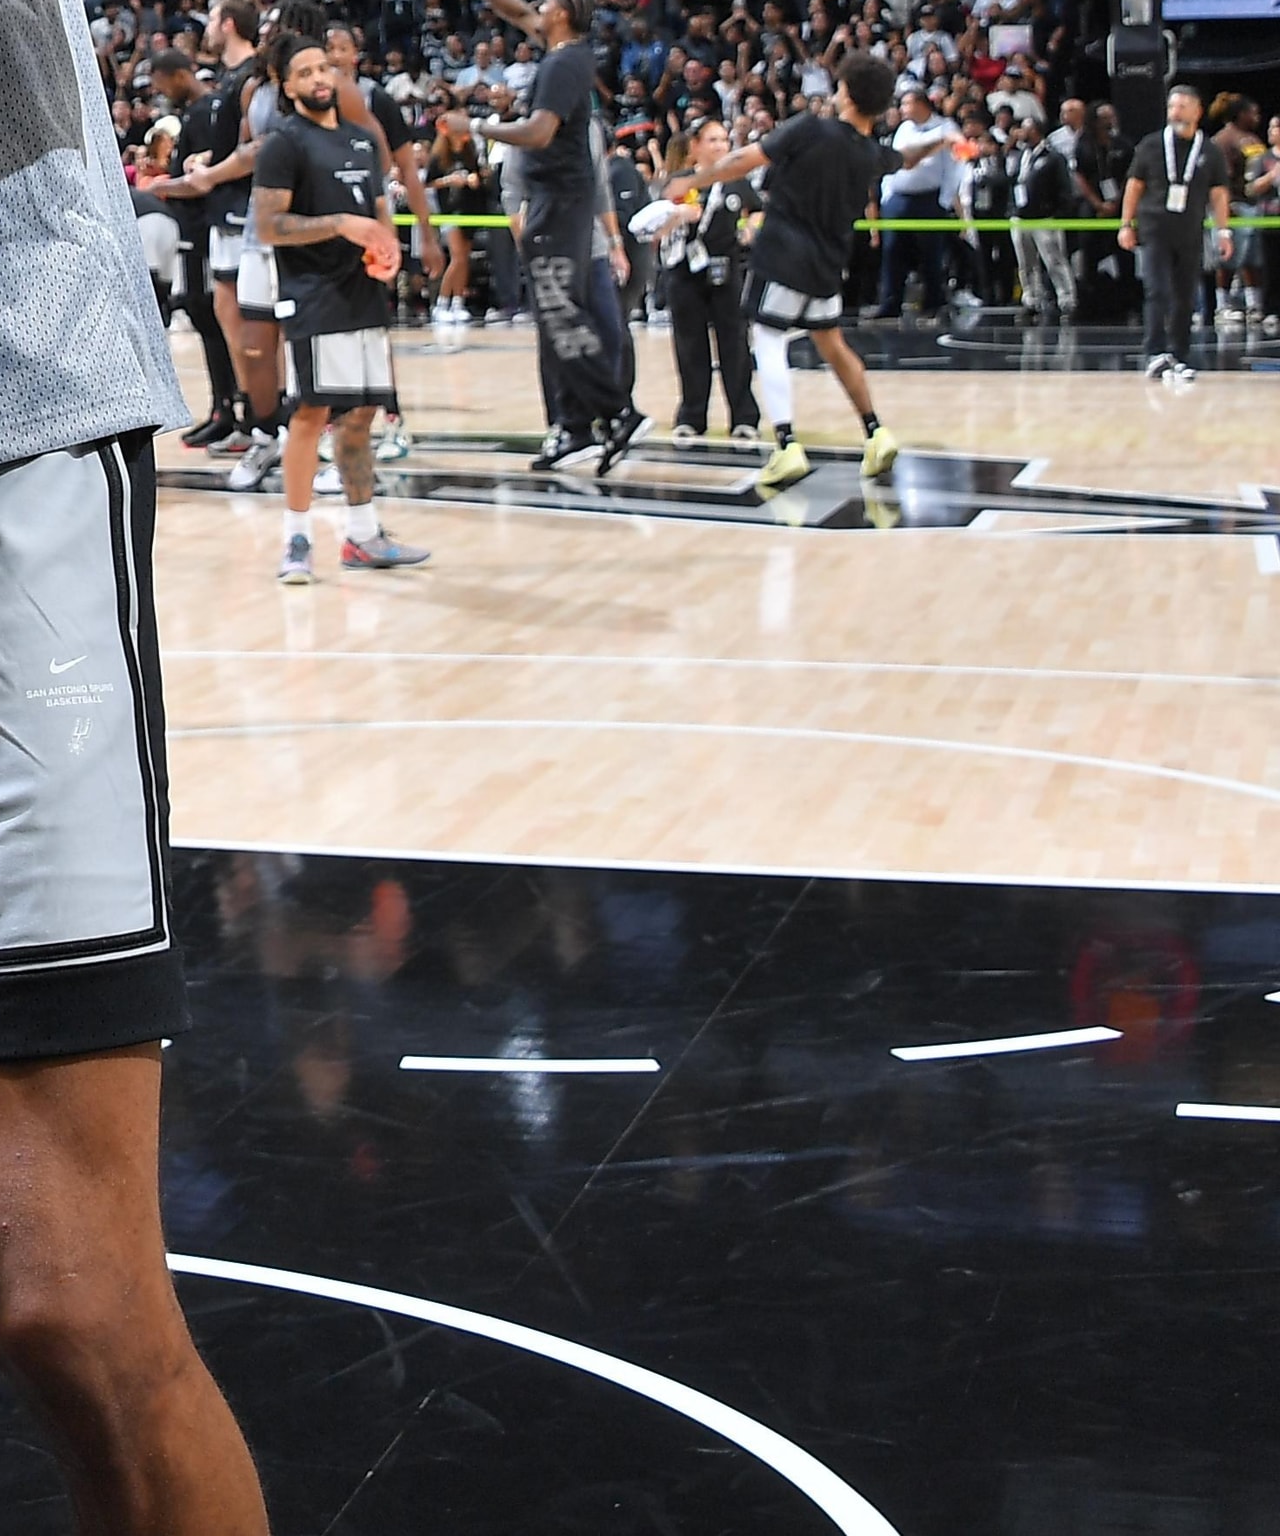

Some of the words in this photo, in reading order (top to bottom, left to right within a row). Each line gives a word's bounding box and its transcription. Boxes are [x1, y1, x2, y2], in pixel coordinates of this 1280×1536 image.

[25, 688, 47, 699] SAN
[48, 684, 88, 696] ANTONIO
[46, 695, 103, 708] BASKETBALL
